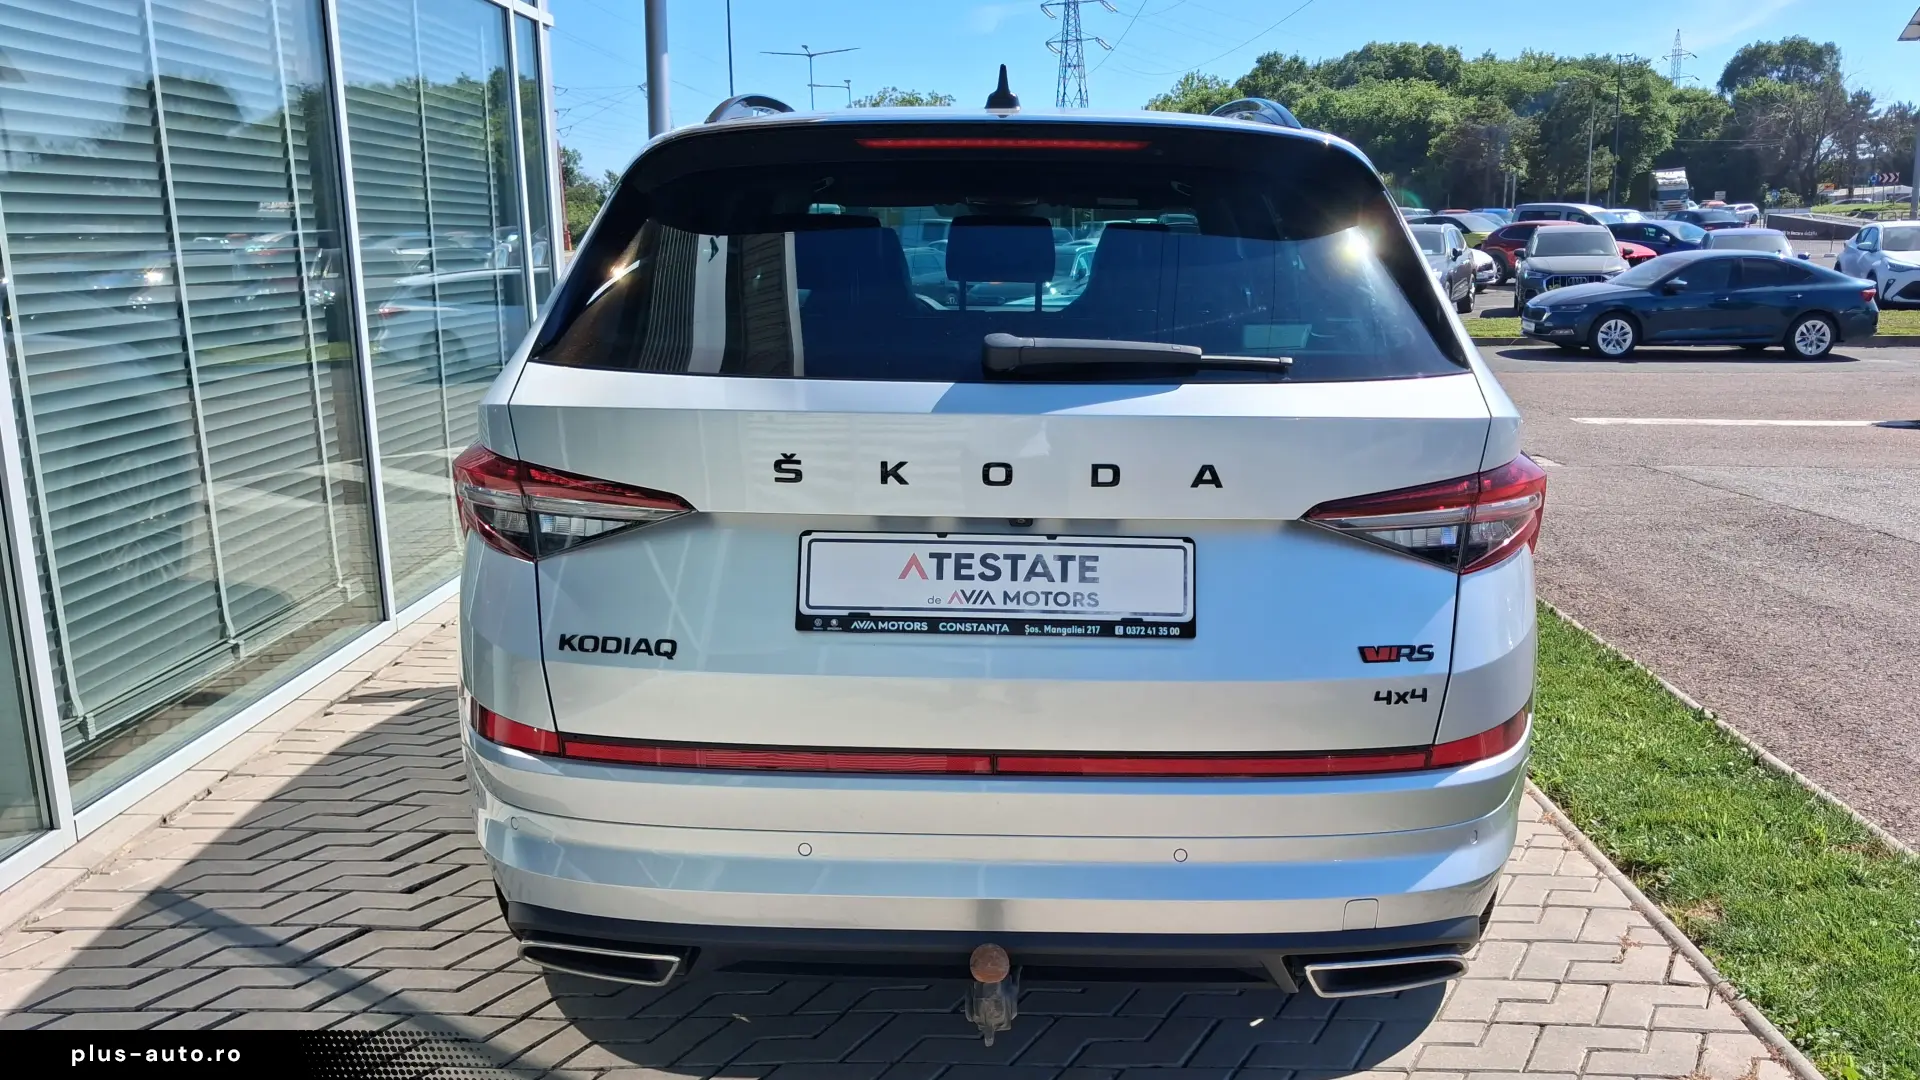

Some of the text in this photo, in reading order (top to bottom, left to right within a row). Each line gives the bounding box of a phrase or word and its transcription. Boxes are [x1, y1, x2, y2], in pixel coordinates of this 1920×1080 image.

[773, 453, 1223, 488] ŠKODA
[898, 552, 1100, 583] ATESTATE
[927, 596, 942, 605] de
[1002, 590, 1100, 607] MOTORS
[878, 621, 929, 631] MOTORS
[1043, 625, 1085, 636] Mangaliei
[1086, 625, 1101, 634] 217
[1126, 625, 1146, 635] 0372
[1147, 626, 1157, 635] 41
[1158, 626, 1168, 635] 35
[1169, 627, 1180, 636] 00
[558, 633, 678, 660] KODIAQ
[1373, 687, 1428, 705] 4x4
